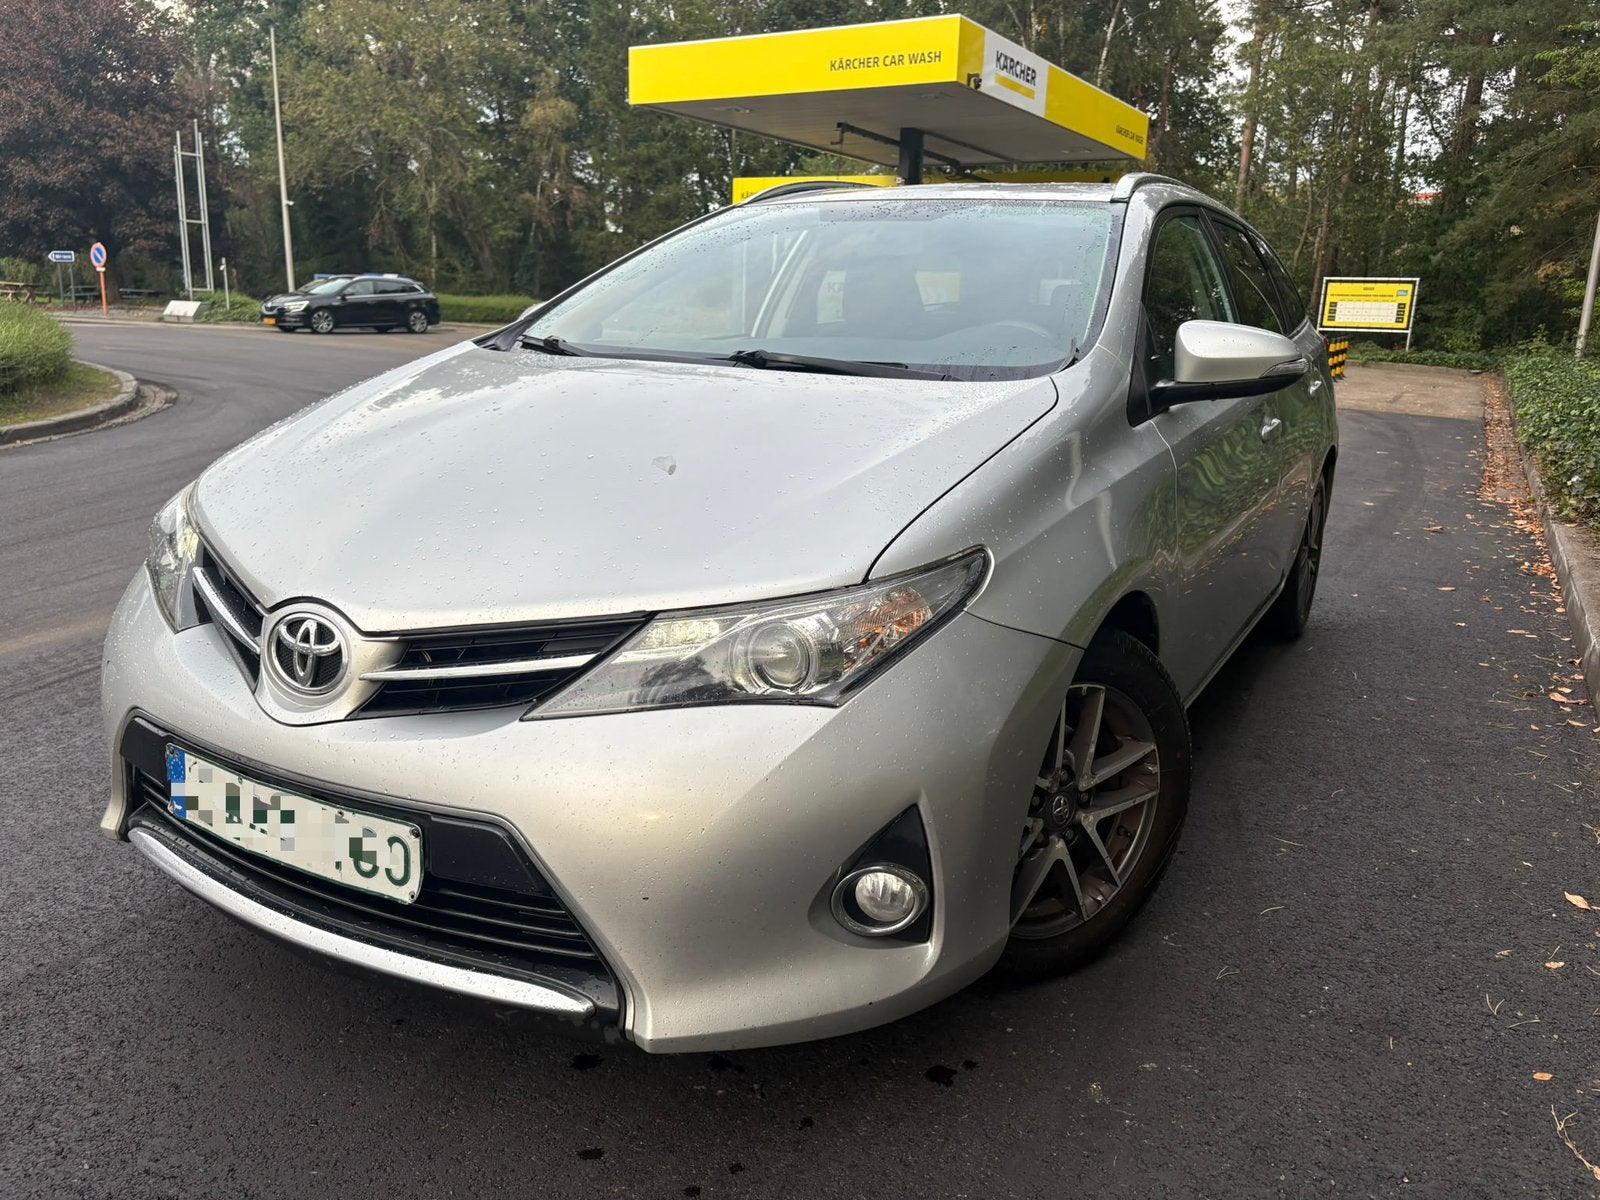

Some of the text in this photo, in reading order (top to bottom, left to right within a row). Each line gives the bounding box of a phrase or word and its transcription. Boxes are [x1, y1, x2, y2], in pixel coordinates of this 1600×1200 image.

[829, 50, 942, 71] KÄRCHER CAR WASH
[995, 50, 1037, 86] KÄRCHER
